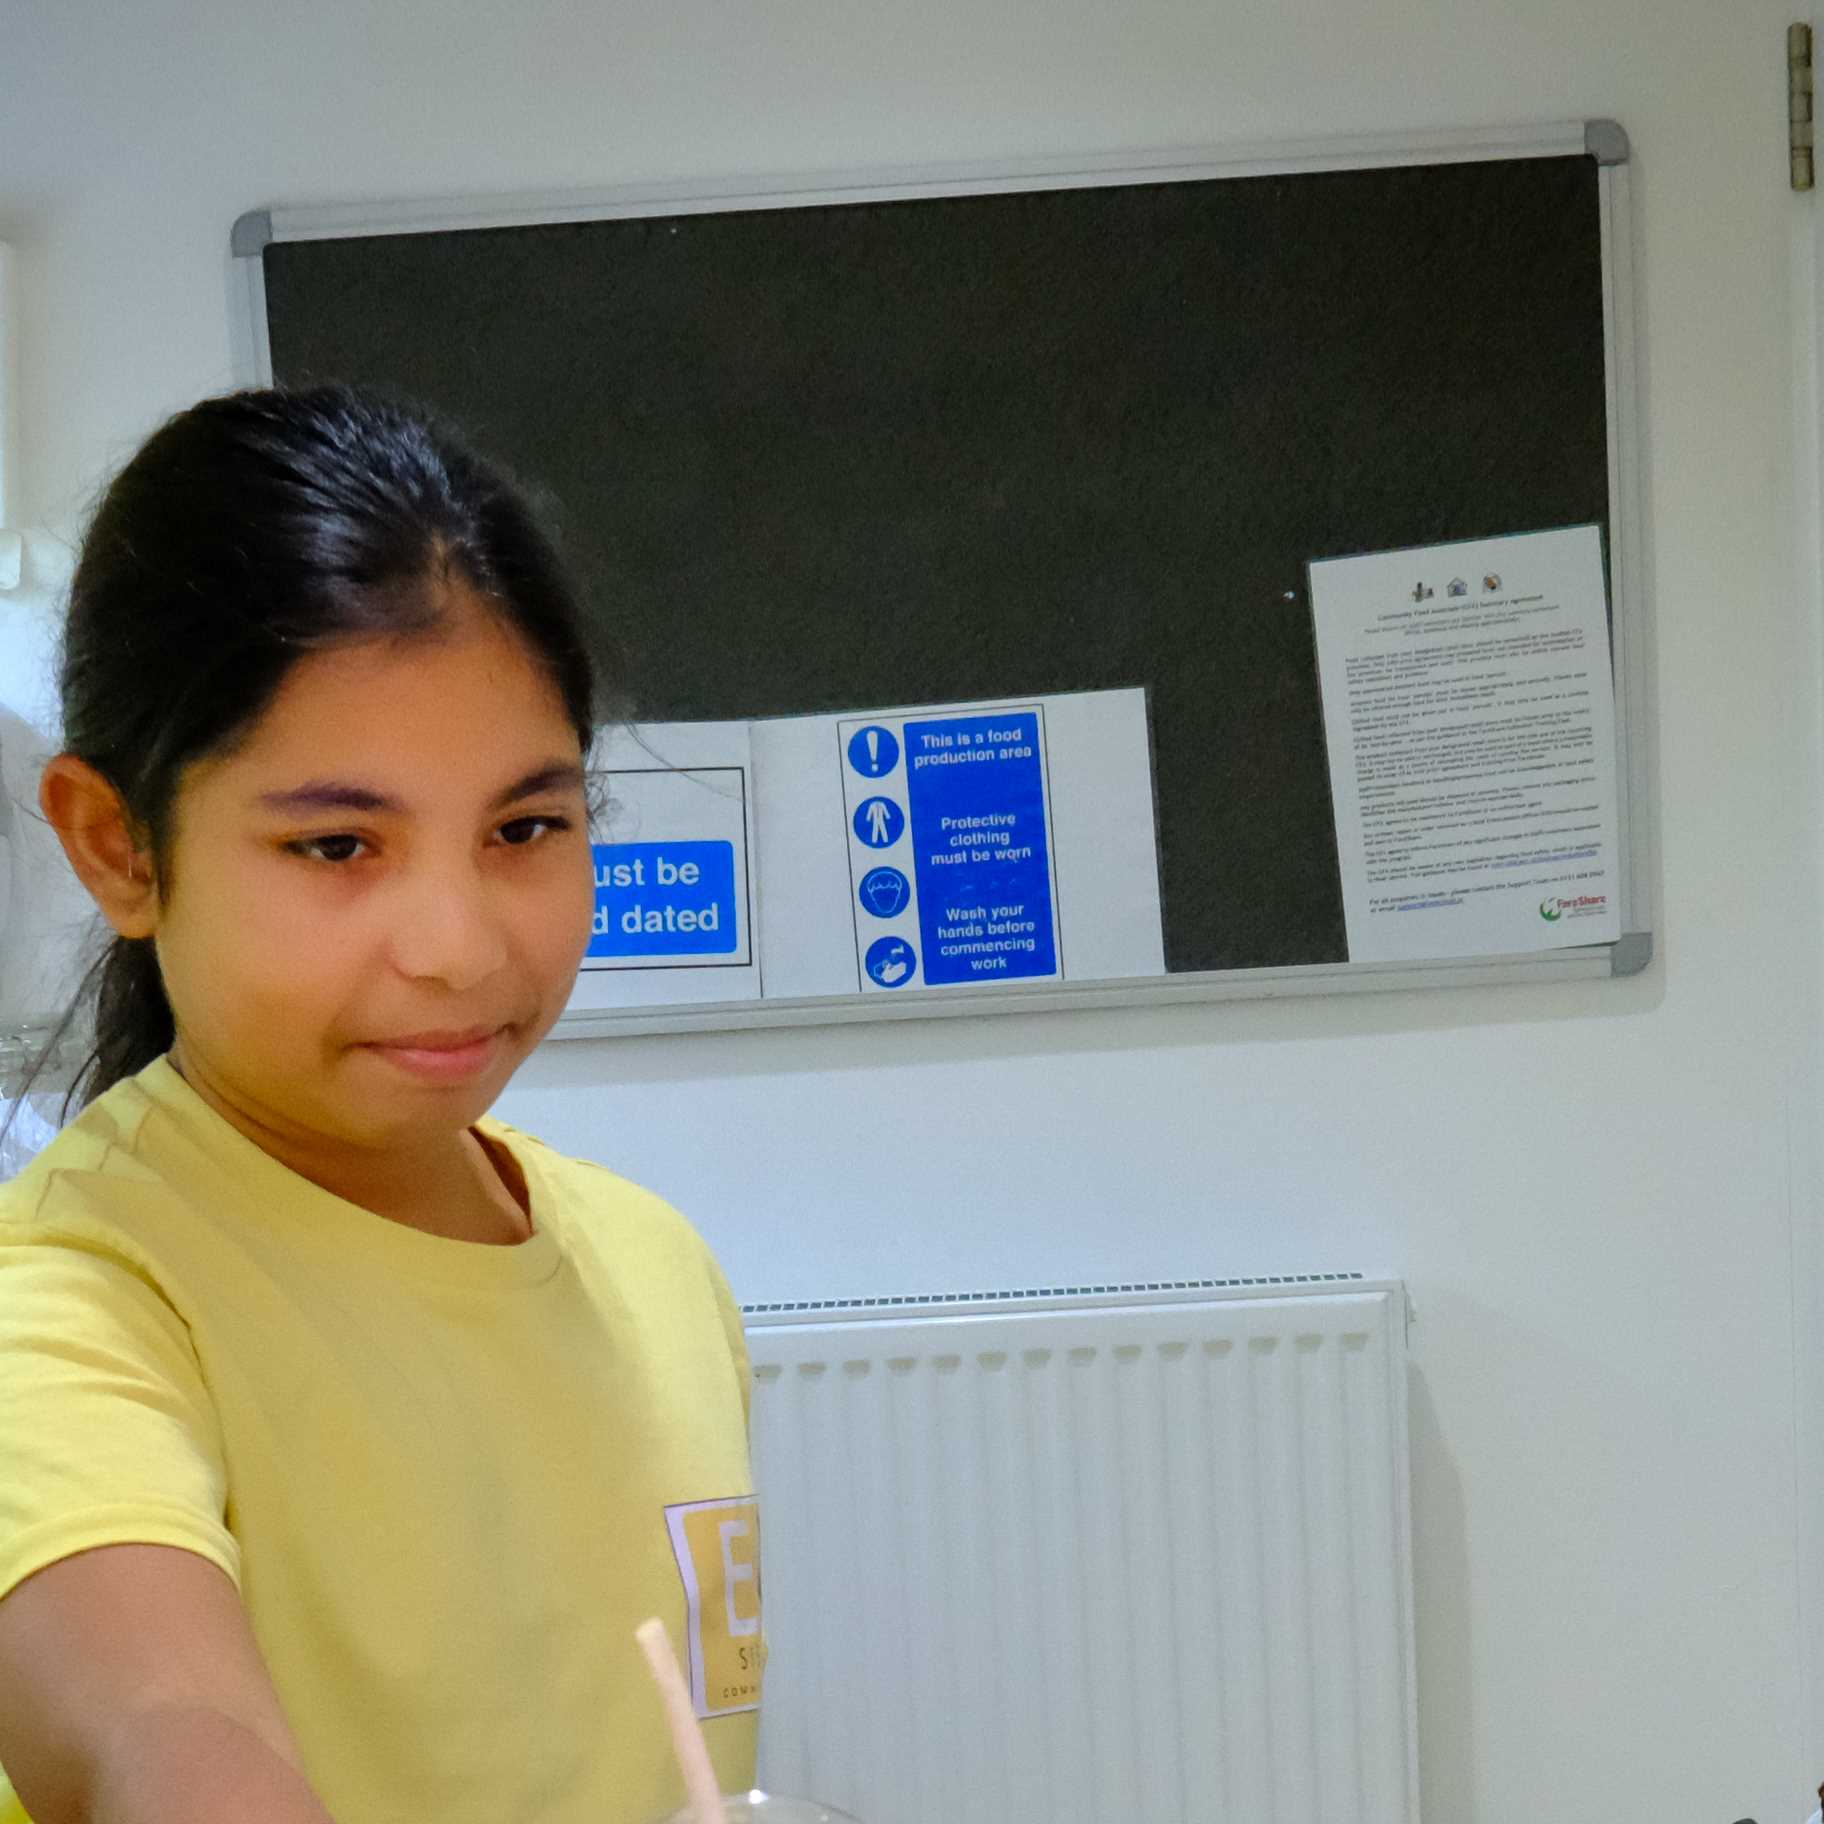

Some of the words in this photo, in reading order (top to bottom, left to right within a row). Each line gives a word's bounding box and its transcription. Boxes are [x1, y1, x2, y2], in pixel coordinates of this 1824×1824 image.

[921, 733, 954, 749] This
[957, 732, 971, 746] is
[975, 732, 984, 744] a
[987, 728, 1022, 743] food
[914, 748, 995, 770] production
[999, 746, 1032, 760] area
[941, 813, 1016, 831] Protective
[950, 831, 1010, 848] clothing
[931, 850, 967, 866] must
[971, 849, 991, 862] be
[995, 847, 1031, 863] worn
[657, 856, 700, 886] be
[621, 902, 719, 934] dated
[946, 906, 987, 922] Wash
[991, 905, 1025, 920] your
[937, 922, 984, 939] hands
[987, 920, 1036, 936] before
[940, 938, 1036, 956] commencing
[971, 956, 1008, 971] work
